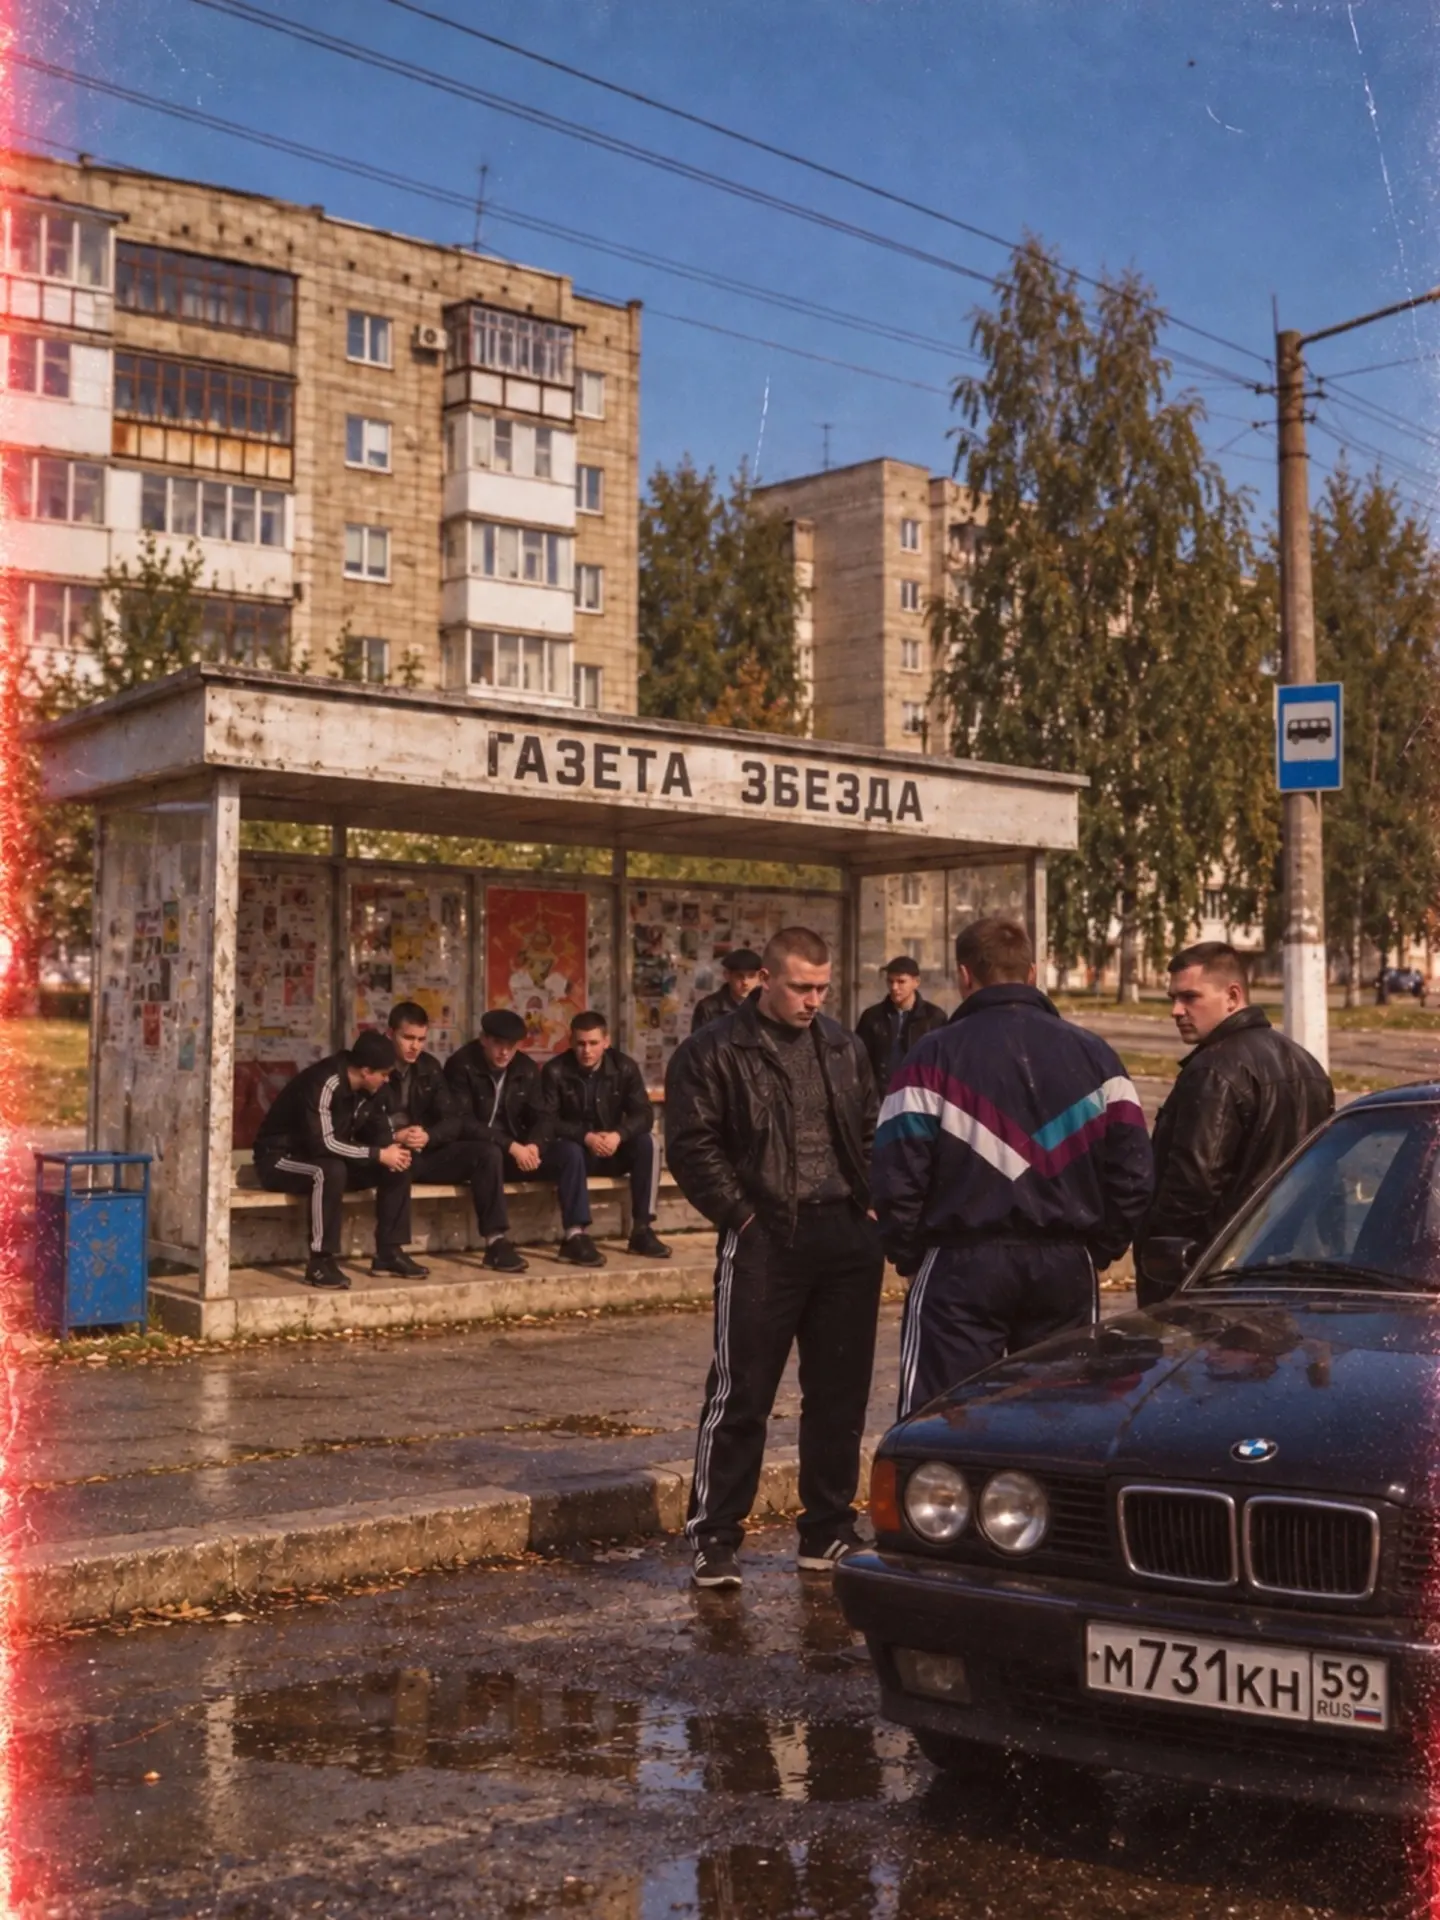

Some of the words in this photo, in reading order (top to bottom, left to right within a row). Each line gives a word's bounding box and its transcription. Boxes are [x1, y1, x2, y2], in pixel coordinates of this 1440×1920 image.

[488, 731, 692, 797] ГАЗЕТА
[1321, 1660, 1369, 1701] 59
[1317, 1699, 1351, 1718] RUS
